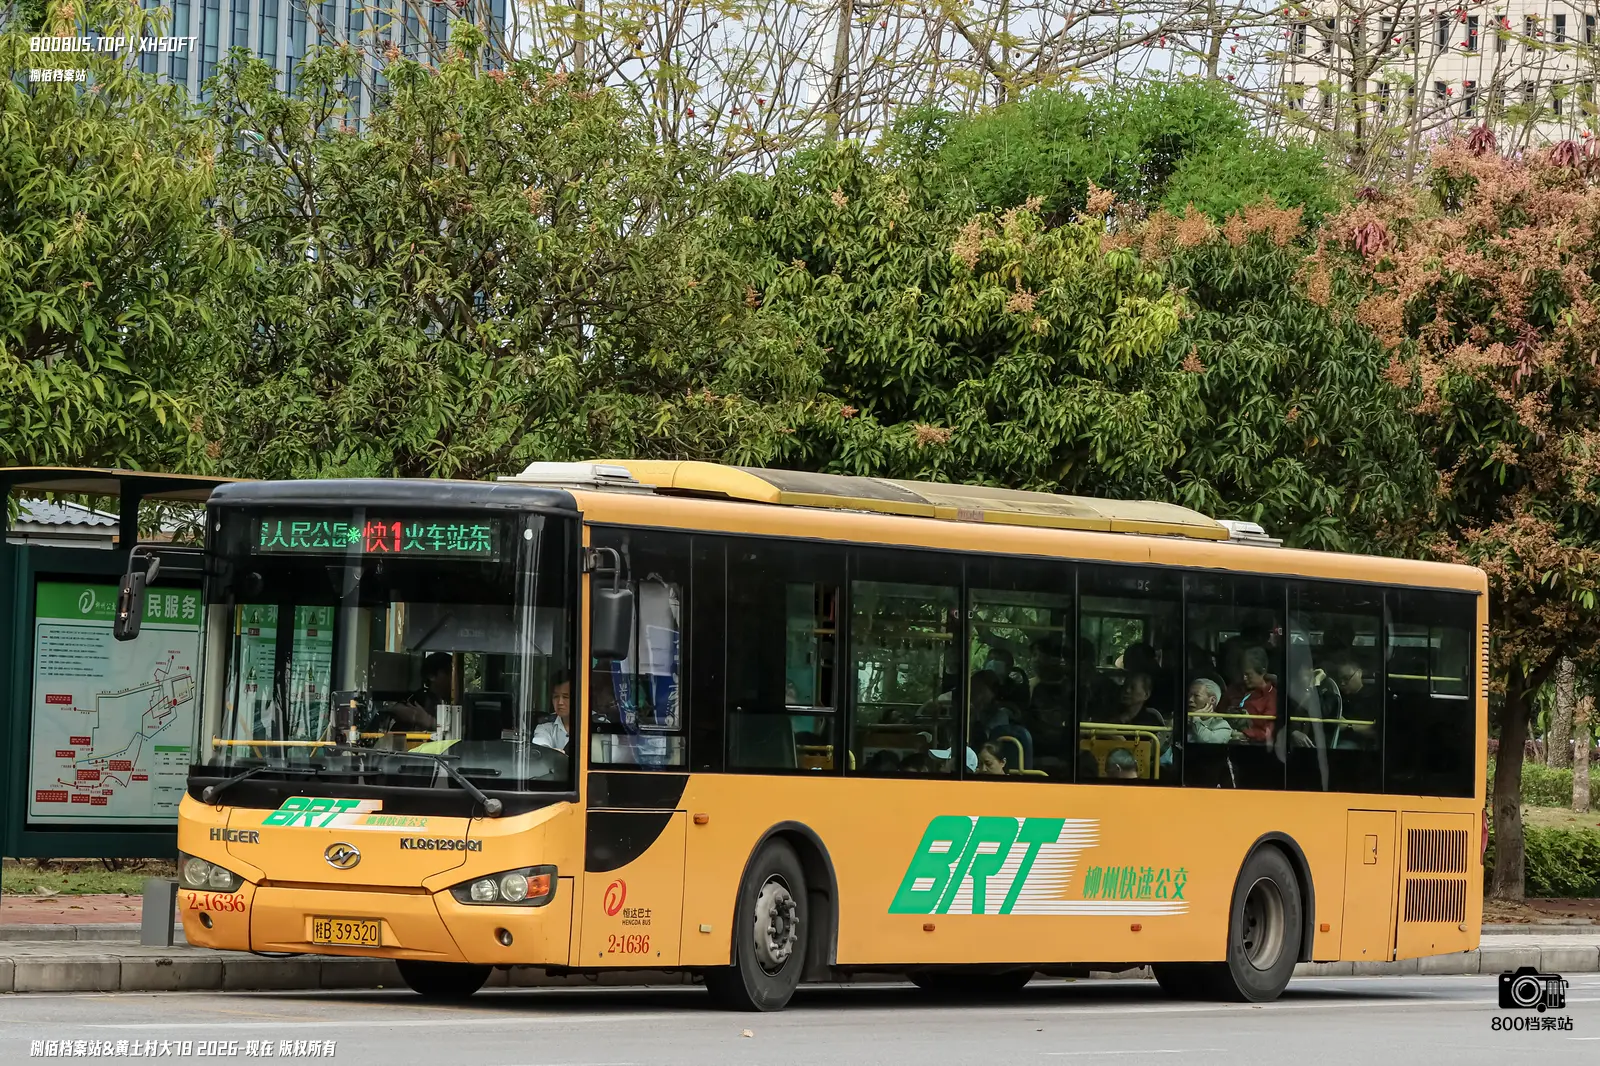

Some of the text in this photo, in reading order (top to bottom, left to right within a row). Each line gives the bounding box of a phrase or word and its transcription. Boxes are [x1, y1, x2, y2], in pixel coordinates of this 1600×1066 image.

[363, 521, 402, 553] 快1
[403, 523, 491, 551] 火车站东
[147, 594, 196, 619] 民服务
[261, 797, 361, 828] BRT
[209, 827, 260, 844] HIGER
[400, 837, 482, 852] KLQ6129GQ1
[887, 815, 1066, 915] BRT
[1083, 865, 1189, 900] 柳州快速公交
[187, 892, 246, 913] 2-1636
[623, 907, 652, 919] 恒达巴士
[607, 933, 650, 954] 2-1636
